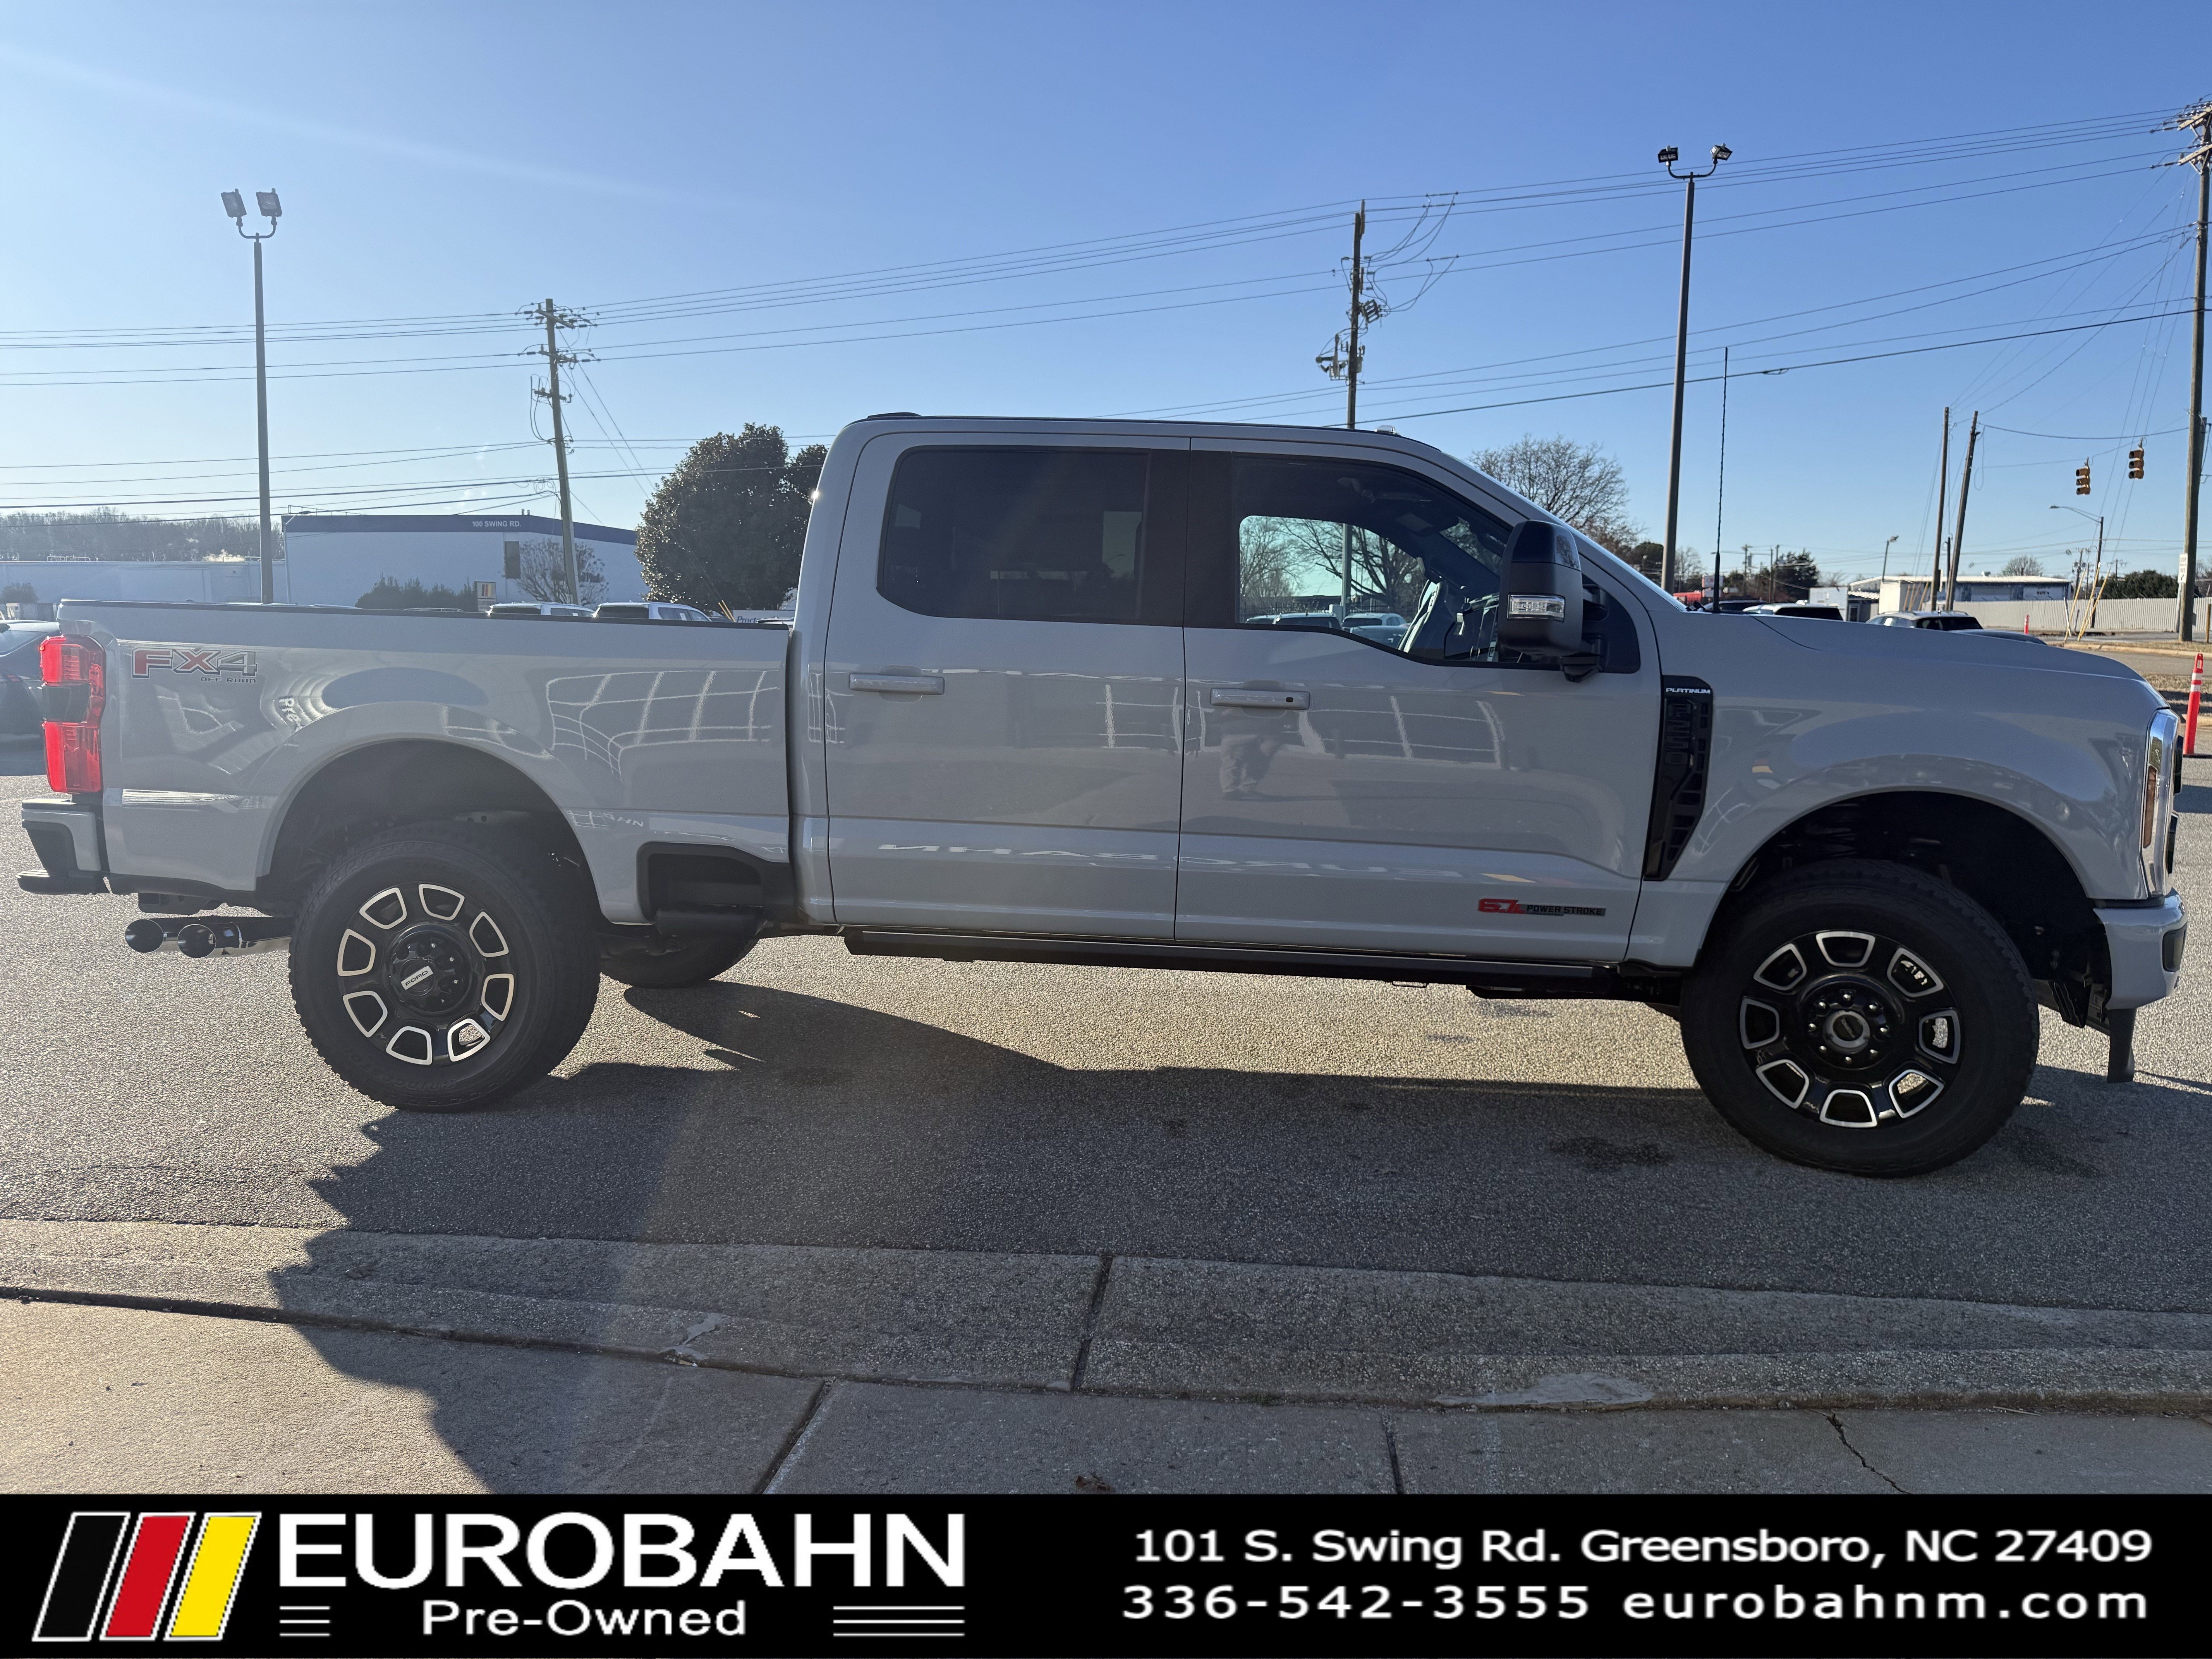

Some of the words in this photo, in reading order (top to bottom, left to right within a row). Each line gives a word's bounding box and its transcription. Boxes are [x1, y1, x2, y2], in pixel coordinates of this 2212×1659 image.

[132, 647, 258, 678] FX4
[1527, 904, 1561, 913] POWER
[1563, 906, 1602, 915] STROKE
[405, 970, 428, 986] FORD
